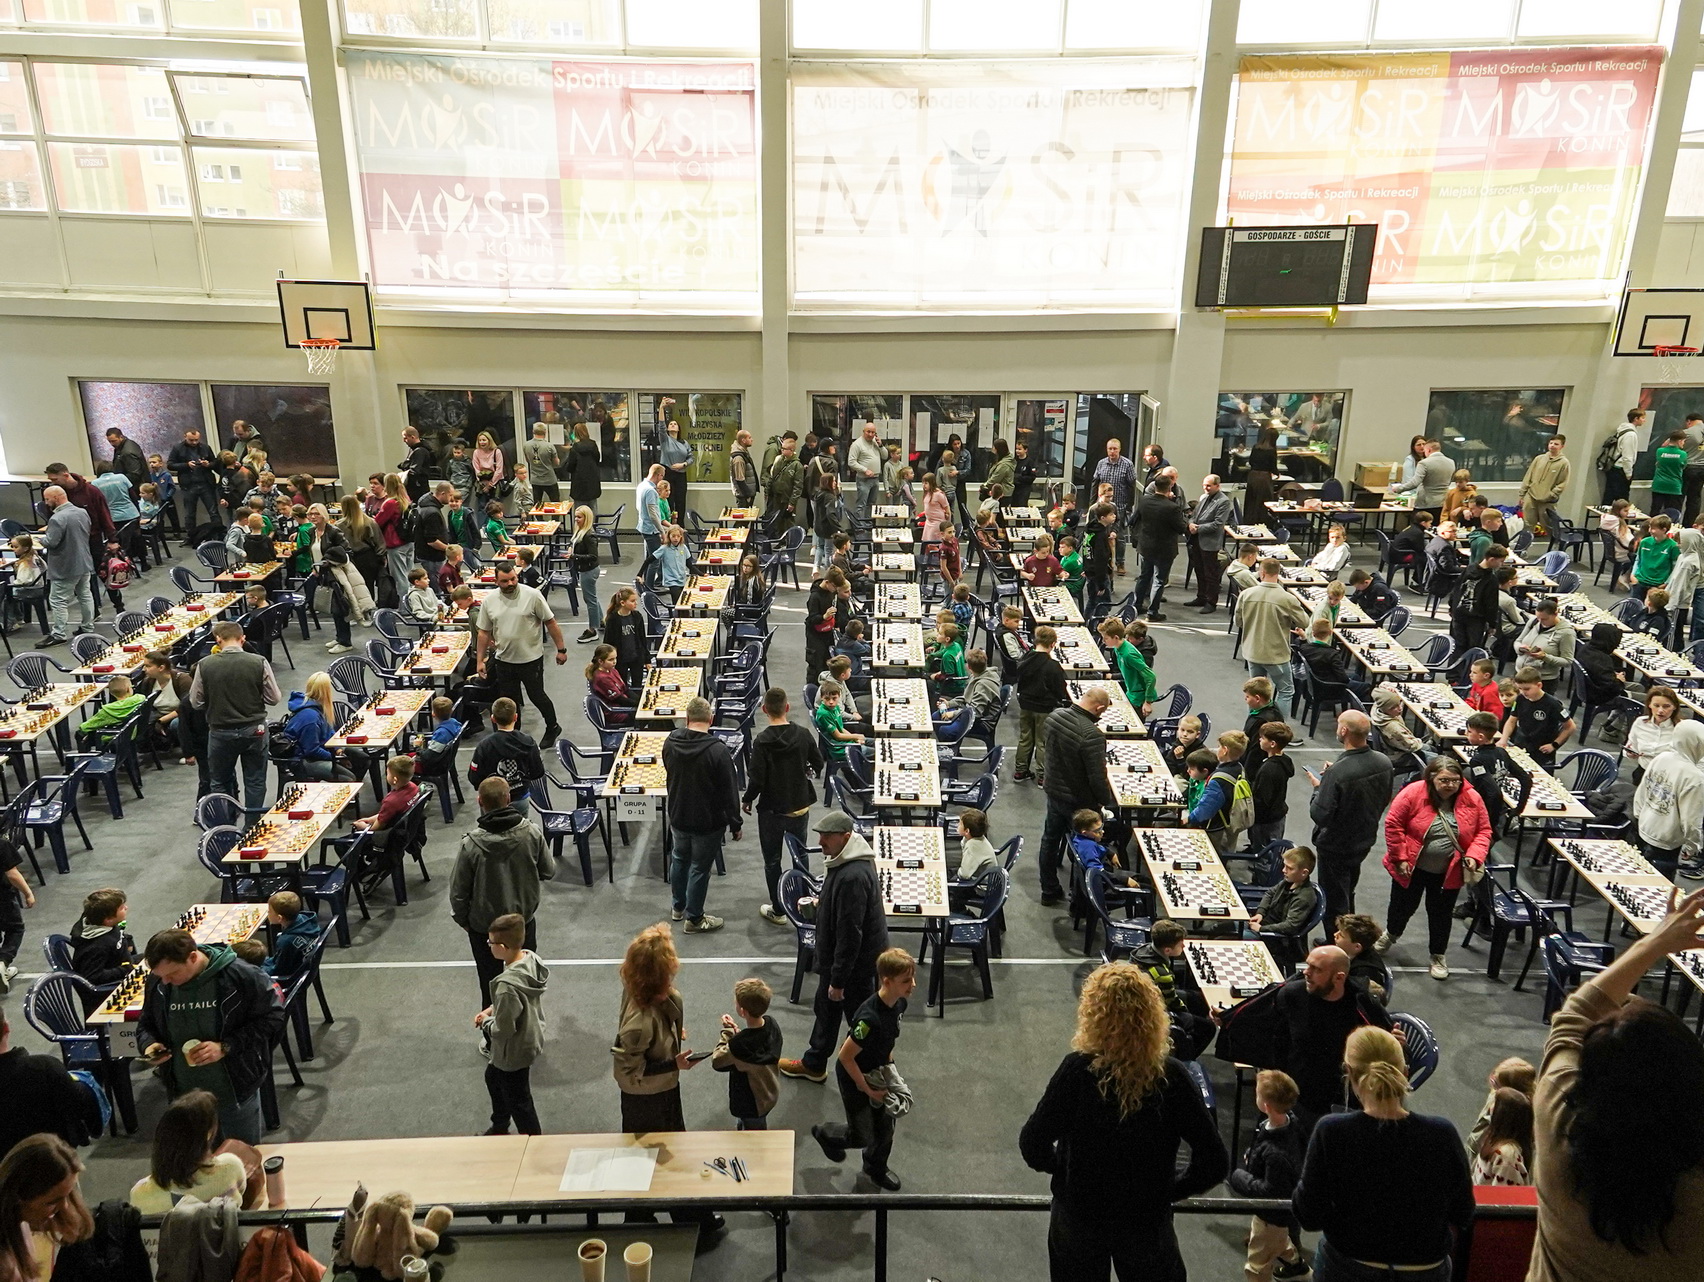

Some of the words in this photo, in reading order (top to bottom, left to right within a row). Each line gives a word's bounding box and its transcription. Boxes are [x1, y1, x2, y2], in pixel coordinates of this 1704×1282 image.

[365, 59, 443, 86] Miejski
[450, 59, 547, 89] Ośrodek
[553, 68, 624, 92] Sportu
[1250, 68, 1288, 82] Miejski
[1290, 67, 1337, 79] Ośrodek
[1340, 67, 1375, 79] Sportu
[1385, 64, 1438, 78] Rekreacji
[1458, 64, 1497, 78] Miejski
[1500, 63, 1547, 75] Ośrodek
[1550, 61, 1585, 75] Sportu
[1588, 61, 1592, 71] i
[1595, 59, 1648, 72] Rekreacji
[814, 90, 885, 114] Miejski
[890, 89, 979, 110] Ośrodek
[1073, 86, 1172, 111] Rekreacji
[1557, 136, 1631, 153] KONIN
[1238, 189, 1272, 202] Miejski
[1275, 188, 1321, 200] Ośrodek
[1324, 188, 1358, 200] Sportu
[1367, 186, 1419, 199] Rekreacji
[1439, 185, 1477, 198] Miejski
[1480, 184, 1525, 196] Ośrodek
[1528, 182, 1563, 195] Sportu
[1247, 231, 1297, 241] GOSPODARZE
[1303, 230, 1331, 240] GOŚCIE
[486, 241, 554, 258] KONIN
[421, 254, 479, 282] Na
[494, 258, 686, 288] szczęście
